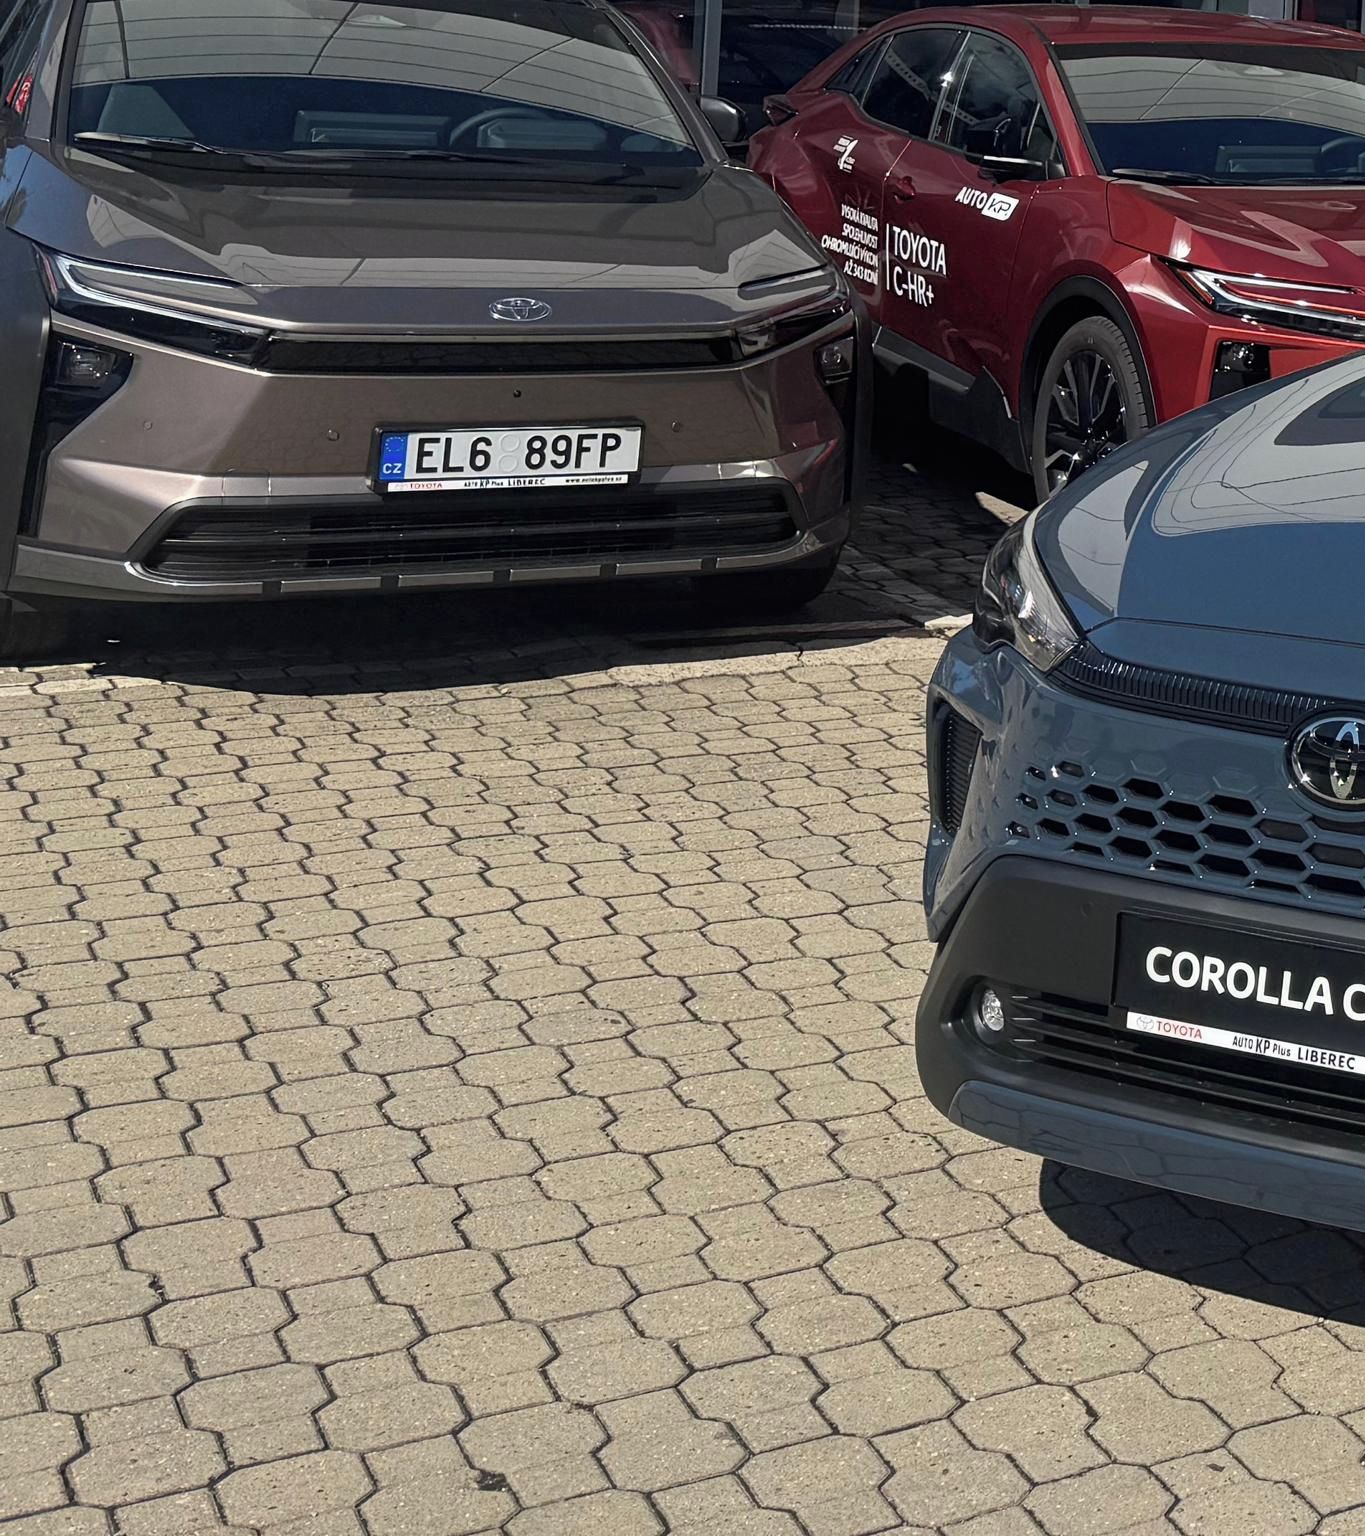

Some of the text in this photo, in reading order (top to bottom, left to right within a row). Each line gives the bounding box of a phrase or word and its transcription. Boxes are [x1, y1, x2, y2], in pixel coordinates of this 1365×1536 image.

[955, 186, 987, 209] AUTO
[892, 226, 947, 276] TOYOTA
[893, 266, 934, 307] C-HR+
[383, 464, 402, 474] CZ
[416, 433, 622, 474] EL6 89FP
[1146, 946, 1334, 1016] COROLLA
[1156, 1020, 1203, 1040] TOYOTA
[1232, 1035, 1253, 1051] AUTO
[1255, 1038, 1271, 1055] KP
[1272, 1042, 1291, 1057] Plus
[1297, 1046, 1356, 1071] LIBEREC
